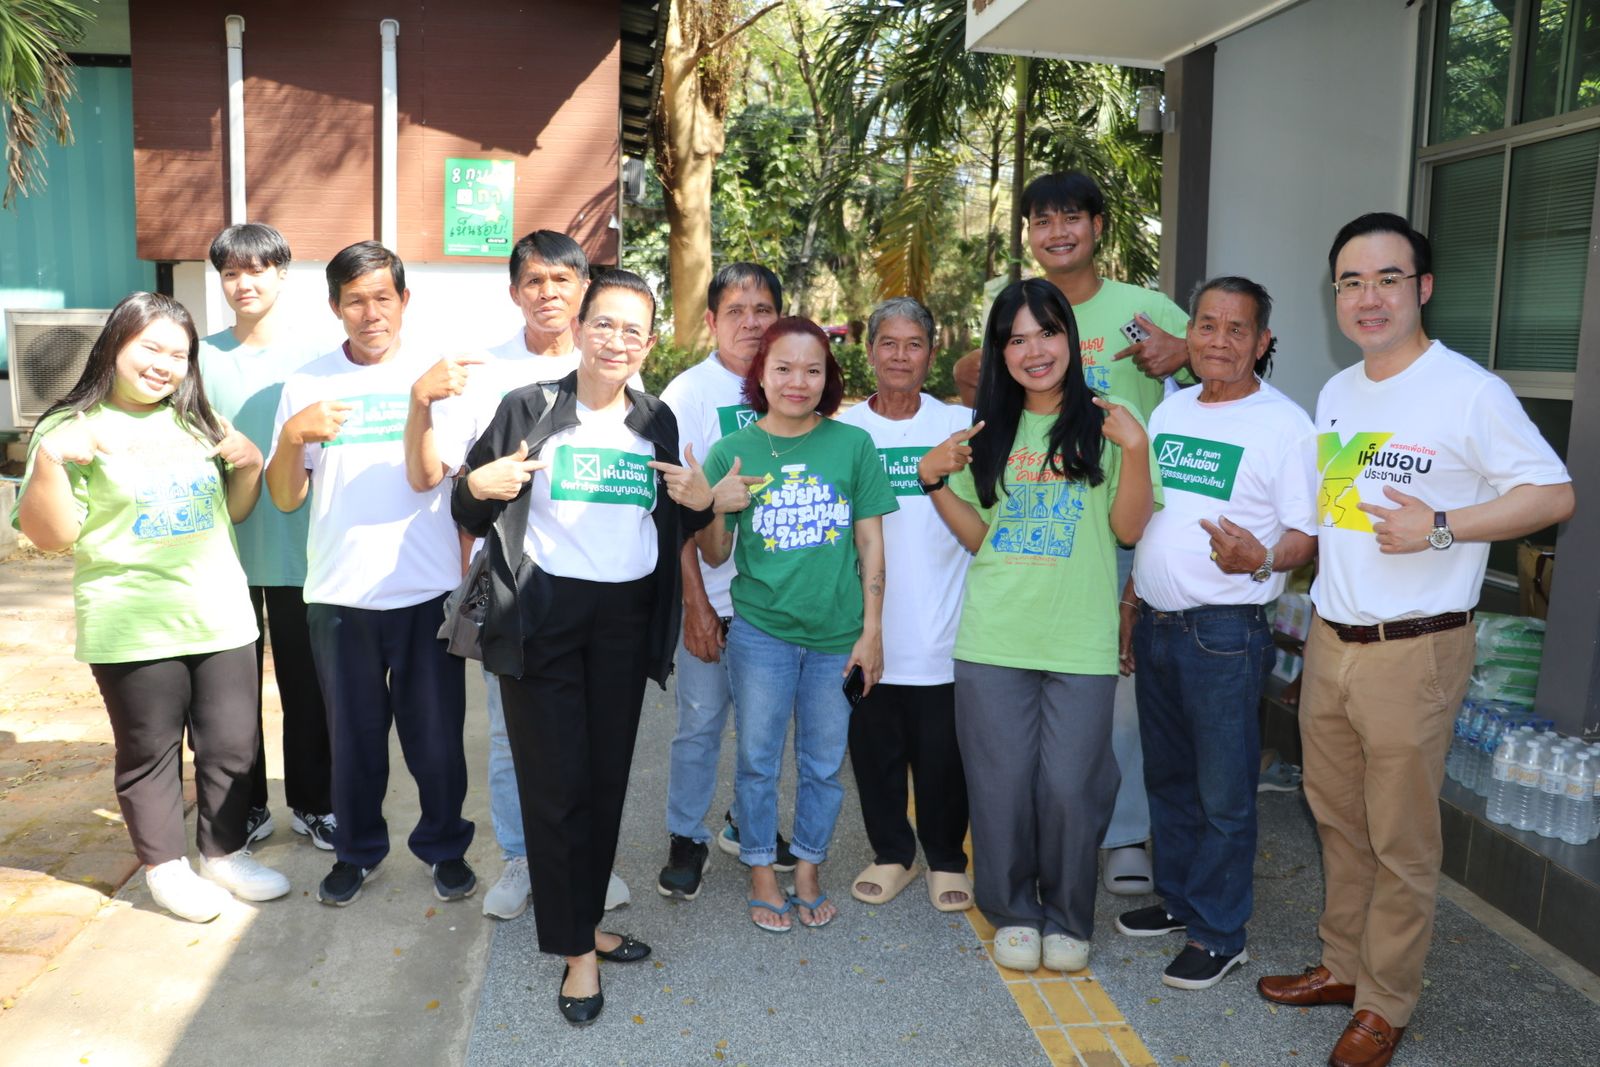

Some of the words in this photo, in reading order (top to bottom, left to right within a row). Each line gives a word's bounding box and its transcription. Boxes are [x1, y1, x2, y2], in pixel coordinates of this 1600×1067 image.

[452, 167, 461, 184] 8
[1195, 448, 1202, 456] 8
[1357, 443, 1432, 474] เห็นชอบ
[889, 461, 918, 475] เห็นช
[1179, 453, 1219, 472] เห็นชอบ
[602, 464, 648, 483] เห็นชอบ
[1364, 468, 1412, 485] ประชามติ
[771, 482, 831, 508] เขียน
[776, 520, 823, 549] ใหม่
